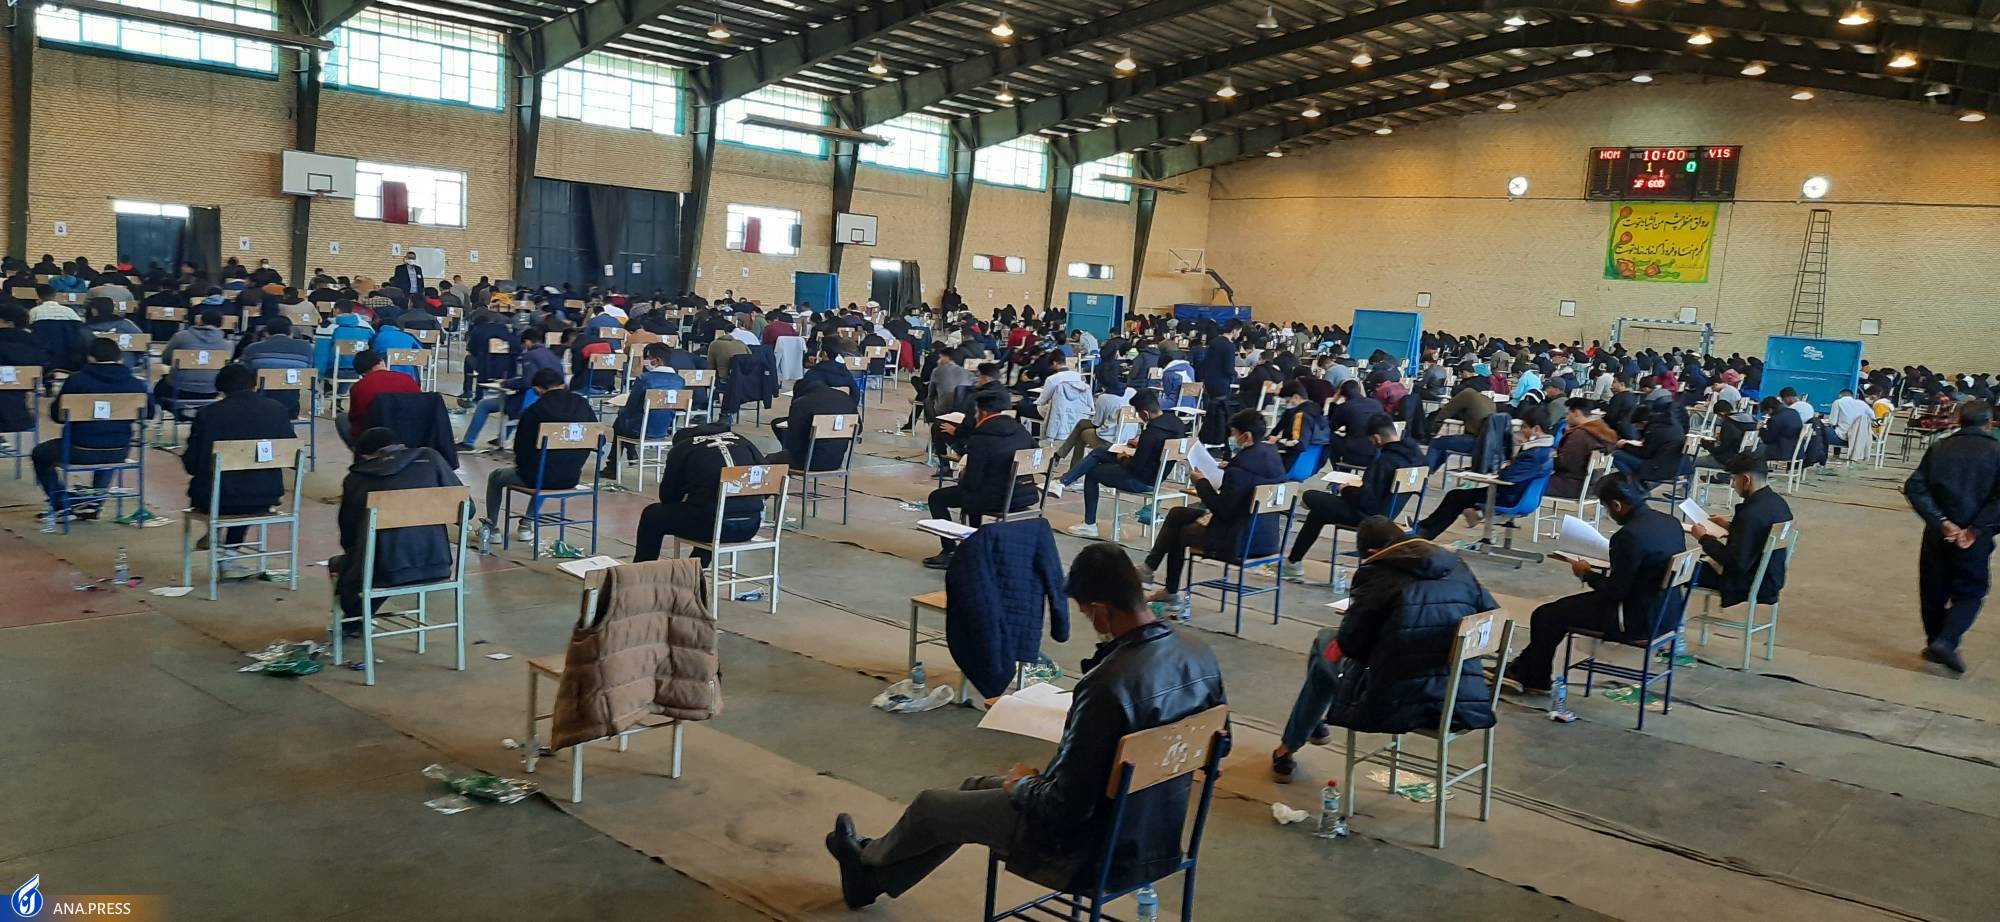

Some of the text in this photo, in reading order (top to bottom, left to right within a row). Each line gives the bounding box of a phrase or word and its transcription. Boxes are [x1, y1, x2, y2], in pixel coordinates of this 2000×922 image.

[1600, 150, 1621, 159] HOM
[1643, 150, 1686, 161] 10:00
[1709, 149, 1731, 158] VIS
[1646, 162, 1652, 172] 1
[1686, 161, 1697, 173] 0
